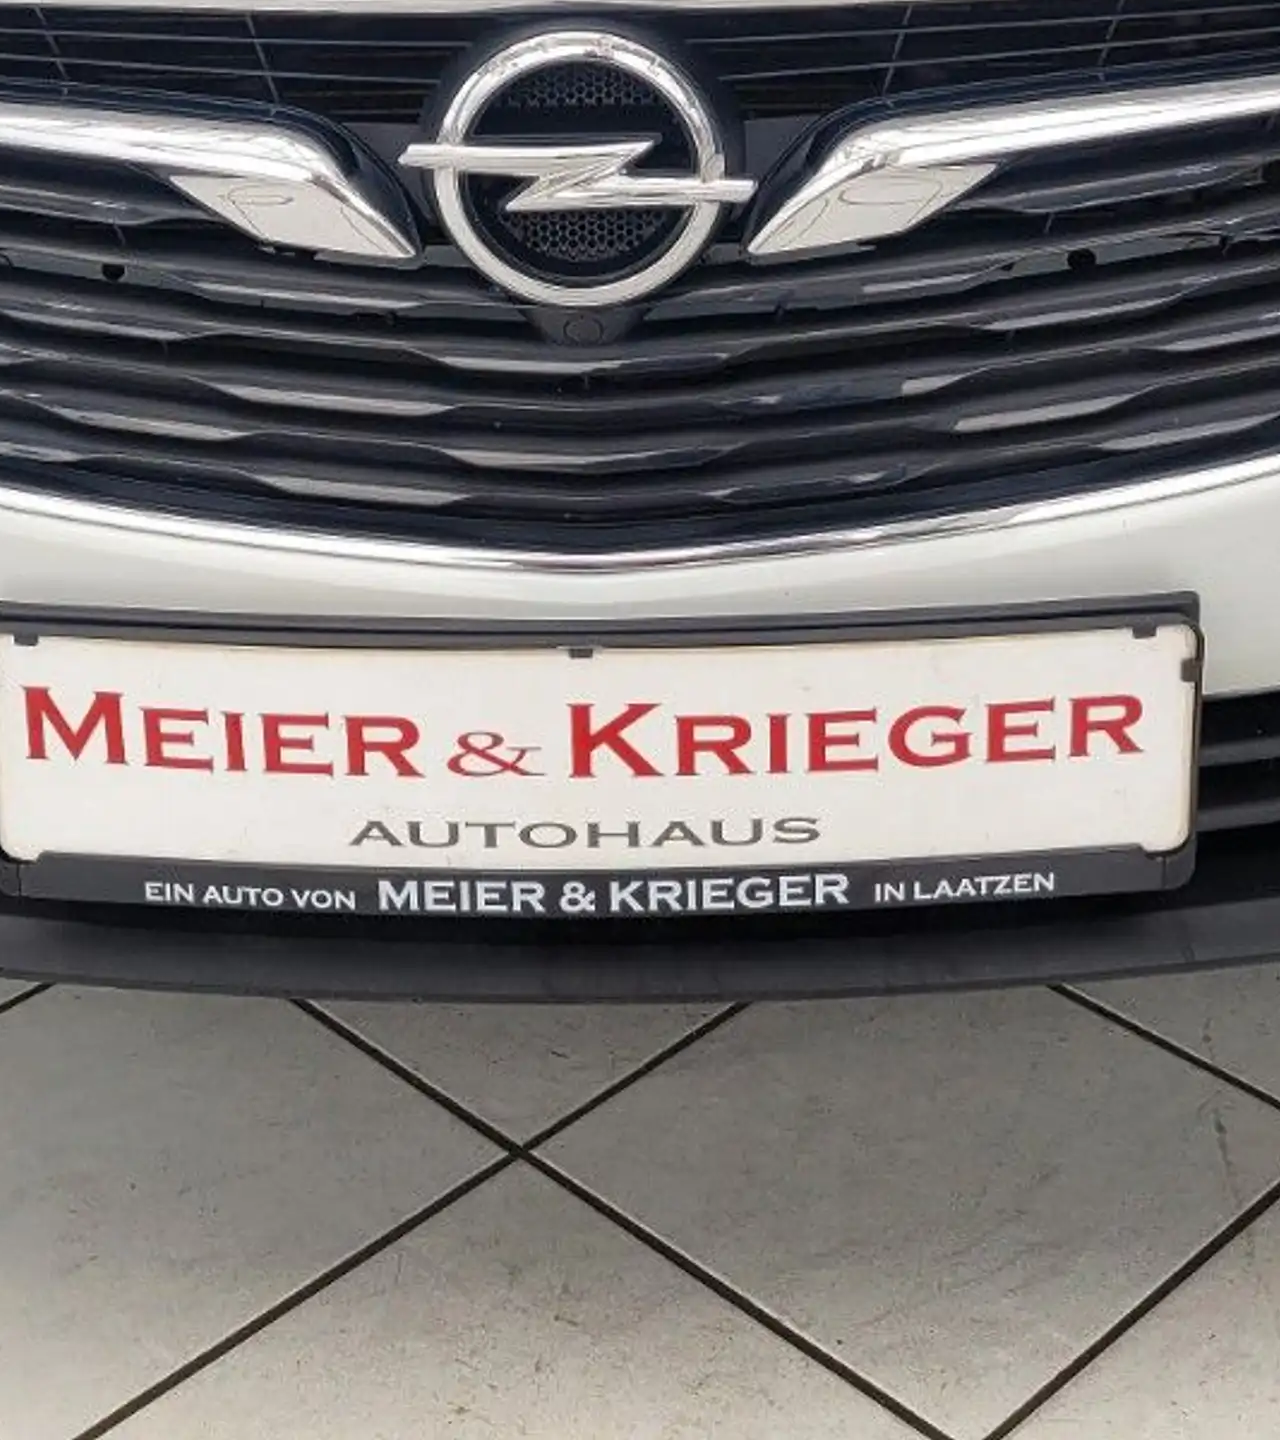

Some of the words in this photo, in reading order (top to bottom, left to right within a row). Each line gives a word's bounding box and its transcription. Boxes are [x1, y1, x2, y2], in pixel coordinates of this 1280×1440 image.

[23, 685, 422, 779] MEIER
[446, 730, 547, 778] &
[567, 693, 1144, 780] KRIEGER
[349, 817, 821, 849] AUTOHAUS
[144, 881, 195, 903] EIN
[202, 885, 284, 907] AUTO
[291, 889, 356, 911] VON
[378, 879, 546, 913] MEIER
[559, 881, 596, 913] &
[610, 873, 850, 913] KRIEGER
[874, 882, 905, 903] IN
[913, 871, 1055, 900] LAATZEN
